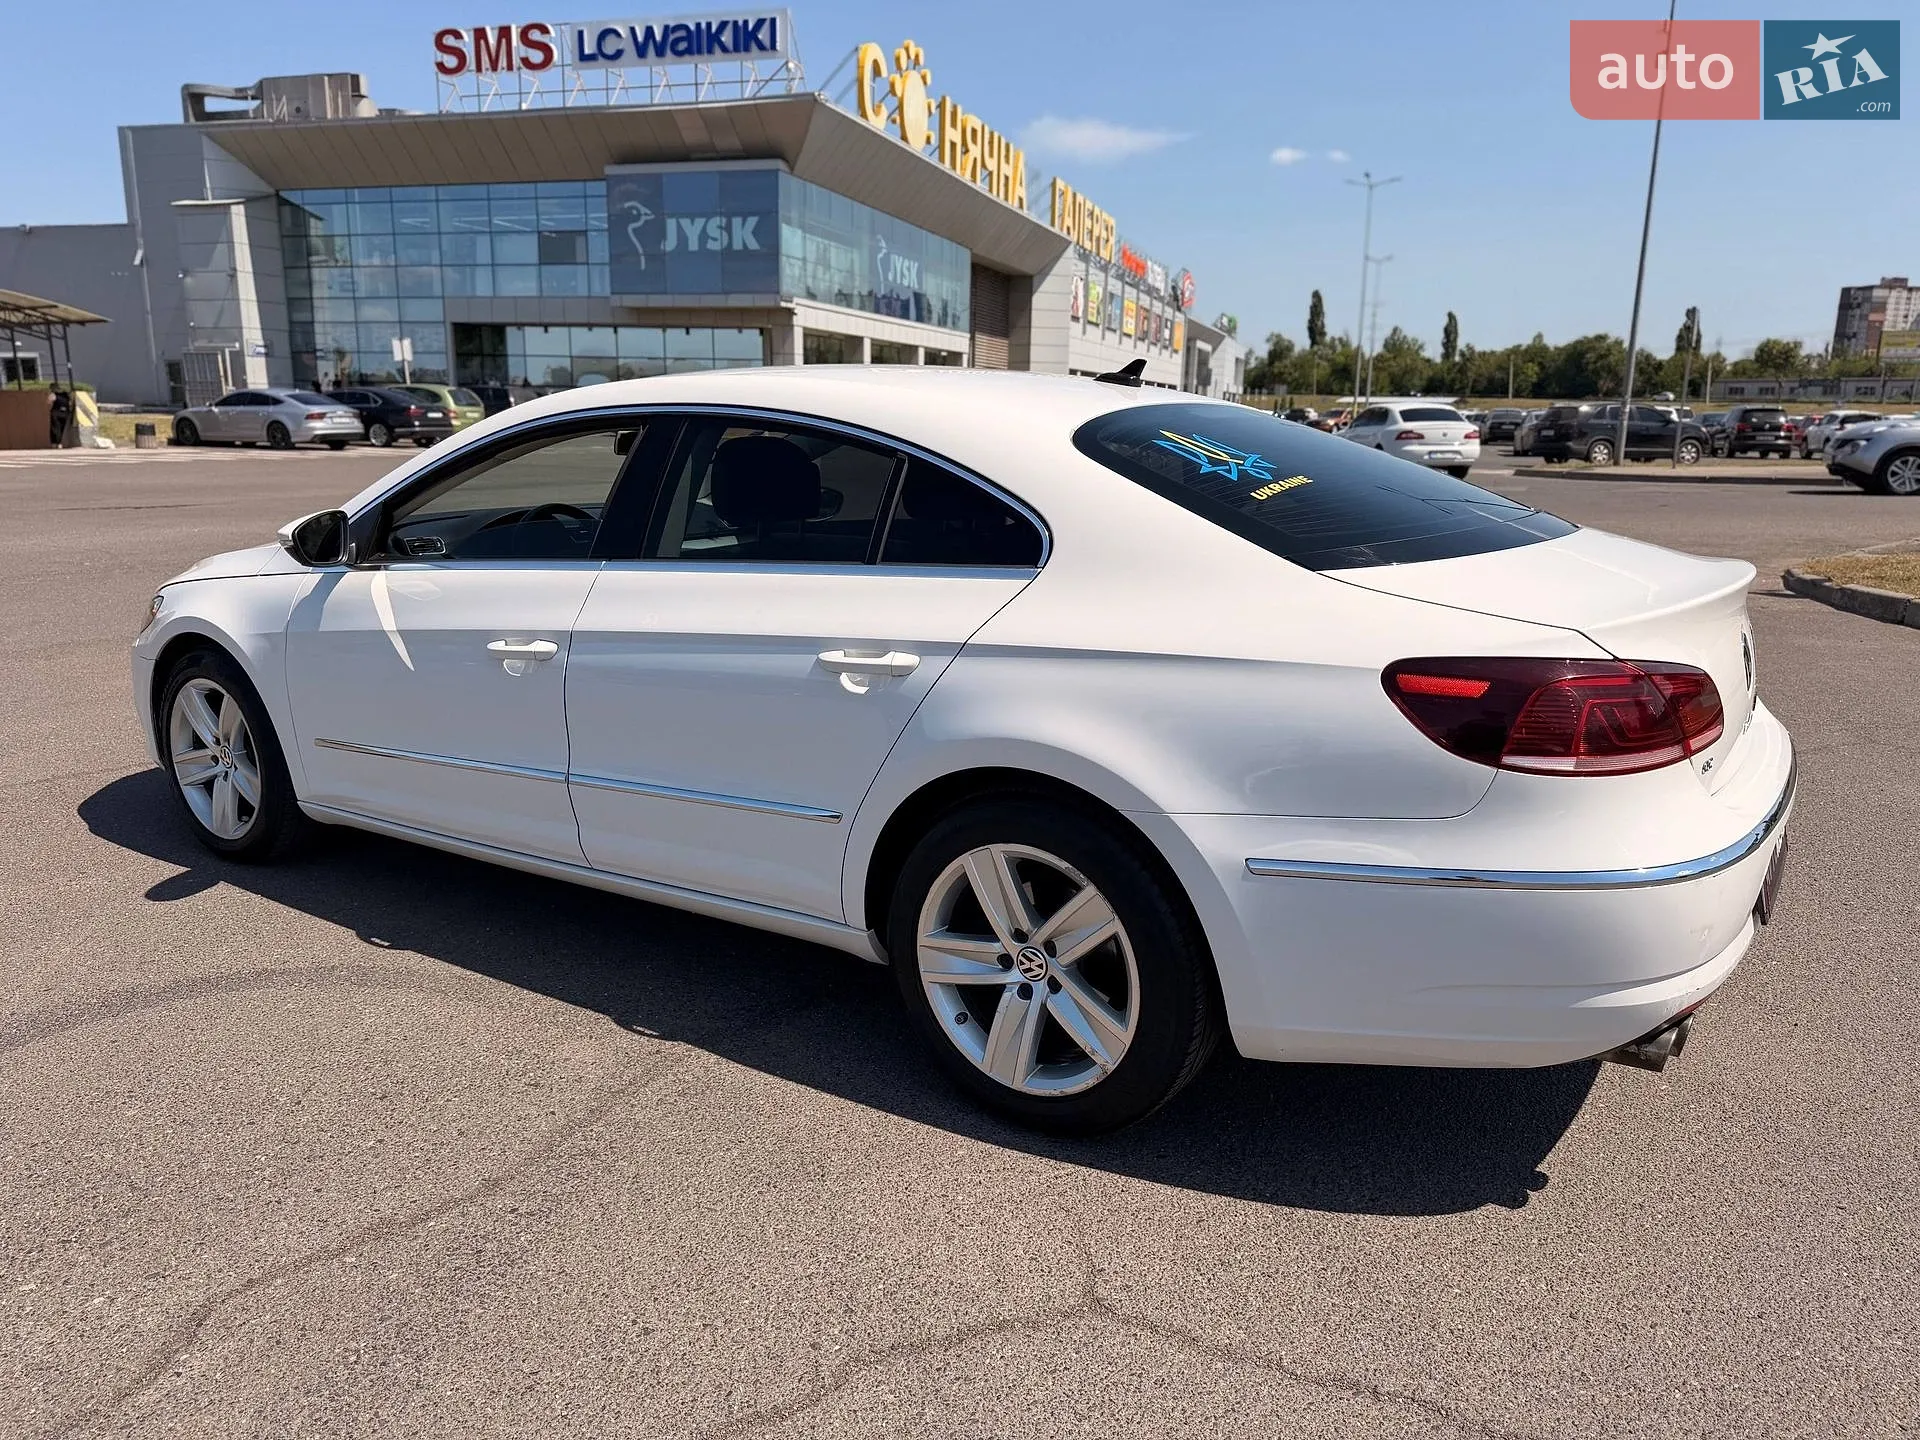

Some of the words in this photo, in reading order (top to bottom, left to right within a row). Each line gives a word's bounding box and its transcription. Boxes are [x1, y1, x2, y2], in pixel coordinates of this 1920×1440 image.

[434, 23, 558, 76] SMS
[578, 28, 624, 62] LC
[662, 216, 760, 251] JYSK
[1051, 176, 1116, 261] ГАЛЕРЕЯ
[889, 255, 919, 289] JYSK
[1250, 475, 1313, 500] UKRAINE
